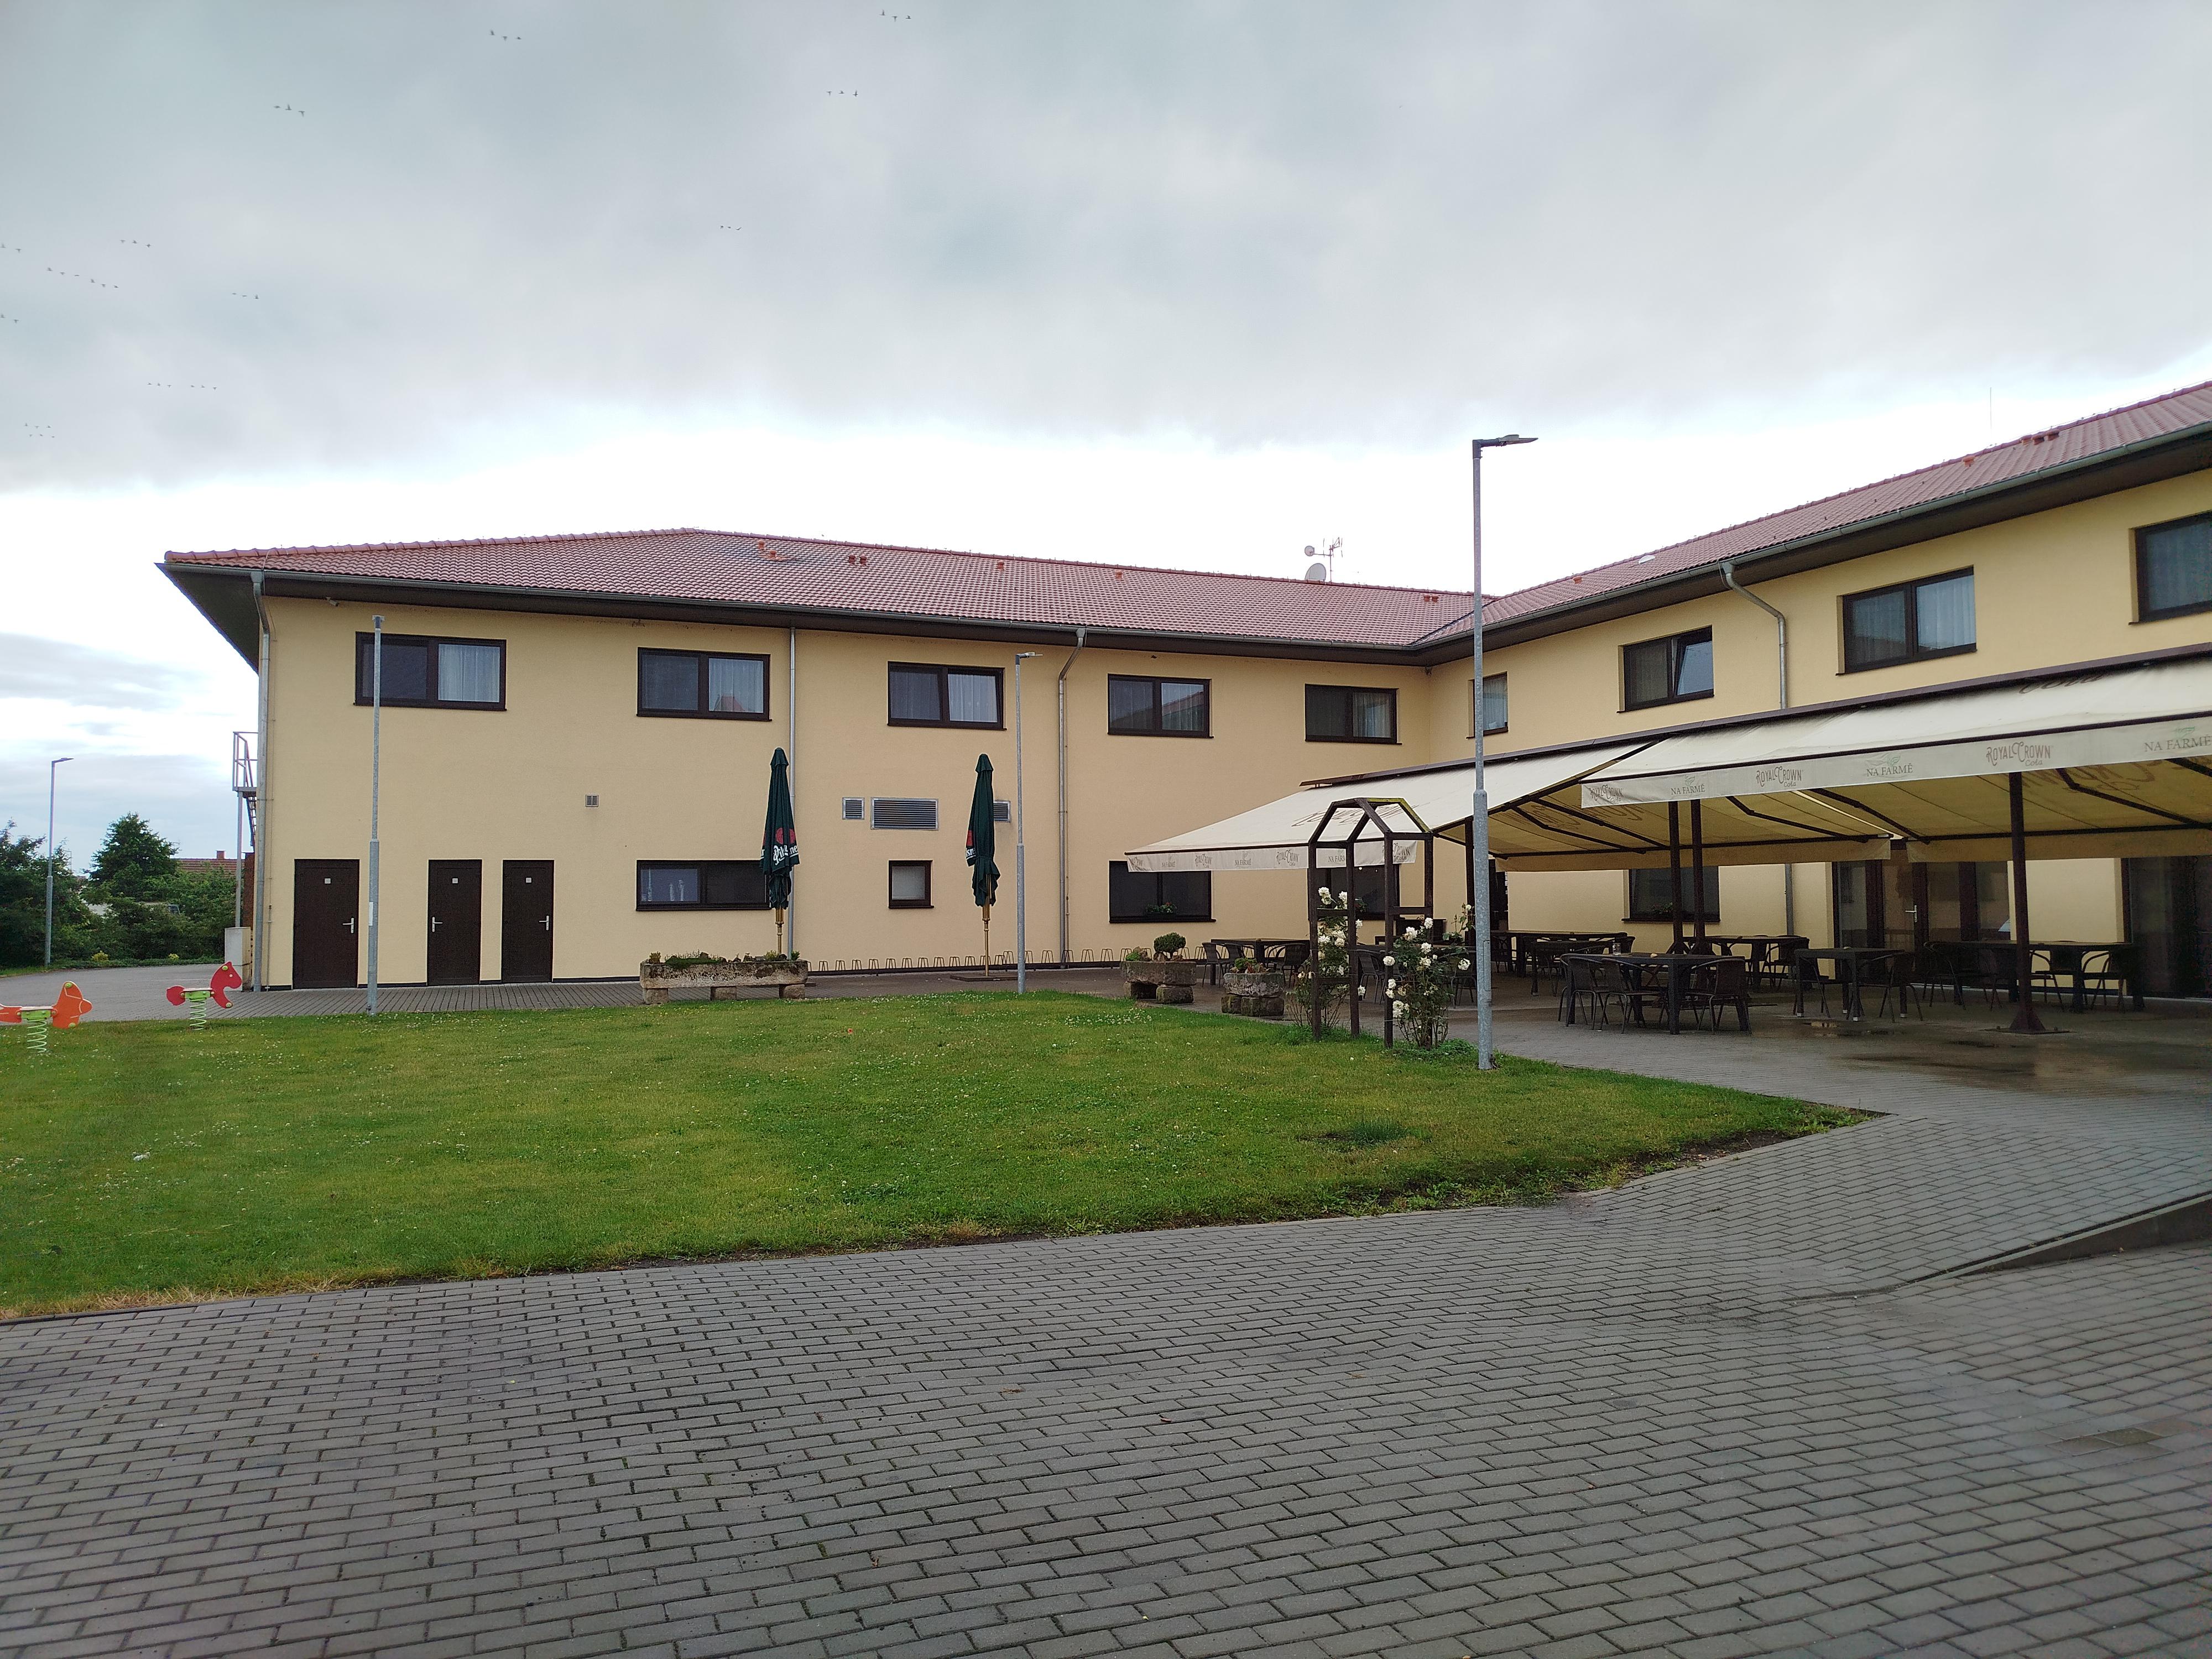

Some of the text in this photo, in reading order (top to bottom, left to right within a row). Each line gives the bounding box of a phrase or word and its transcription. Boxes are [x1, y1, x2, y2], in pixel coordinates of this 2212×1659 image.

[1986, 741, 2051, 766] ROYAL CROWN
[2144, 741, 2163, 752] NA
[1756, 766, 1802, 787] ROYAL CROWN
[1866, 768, 1879, 777] NA
